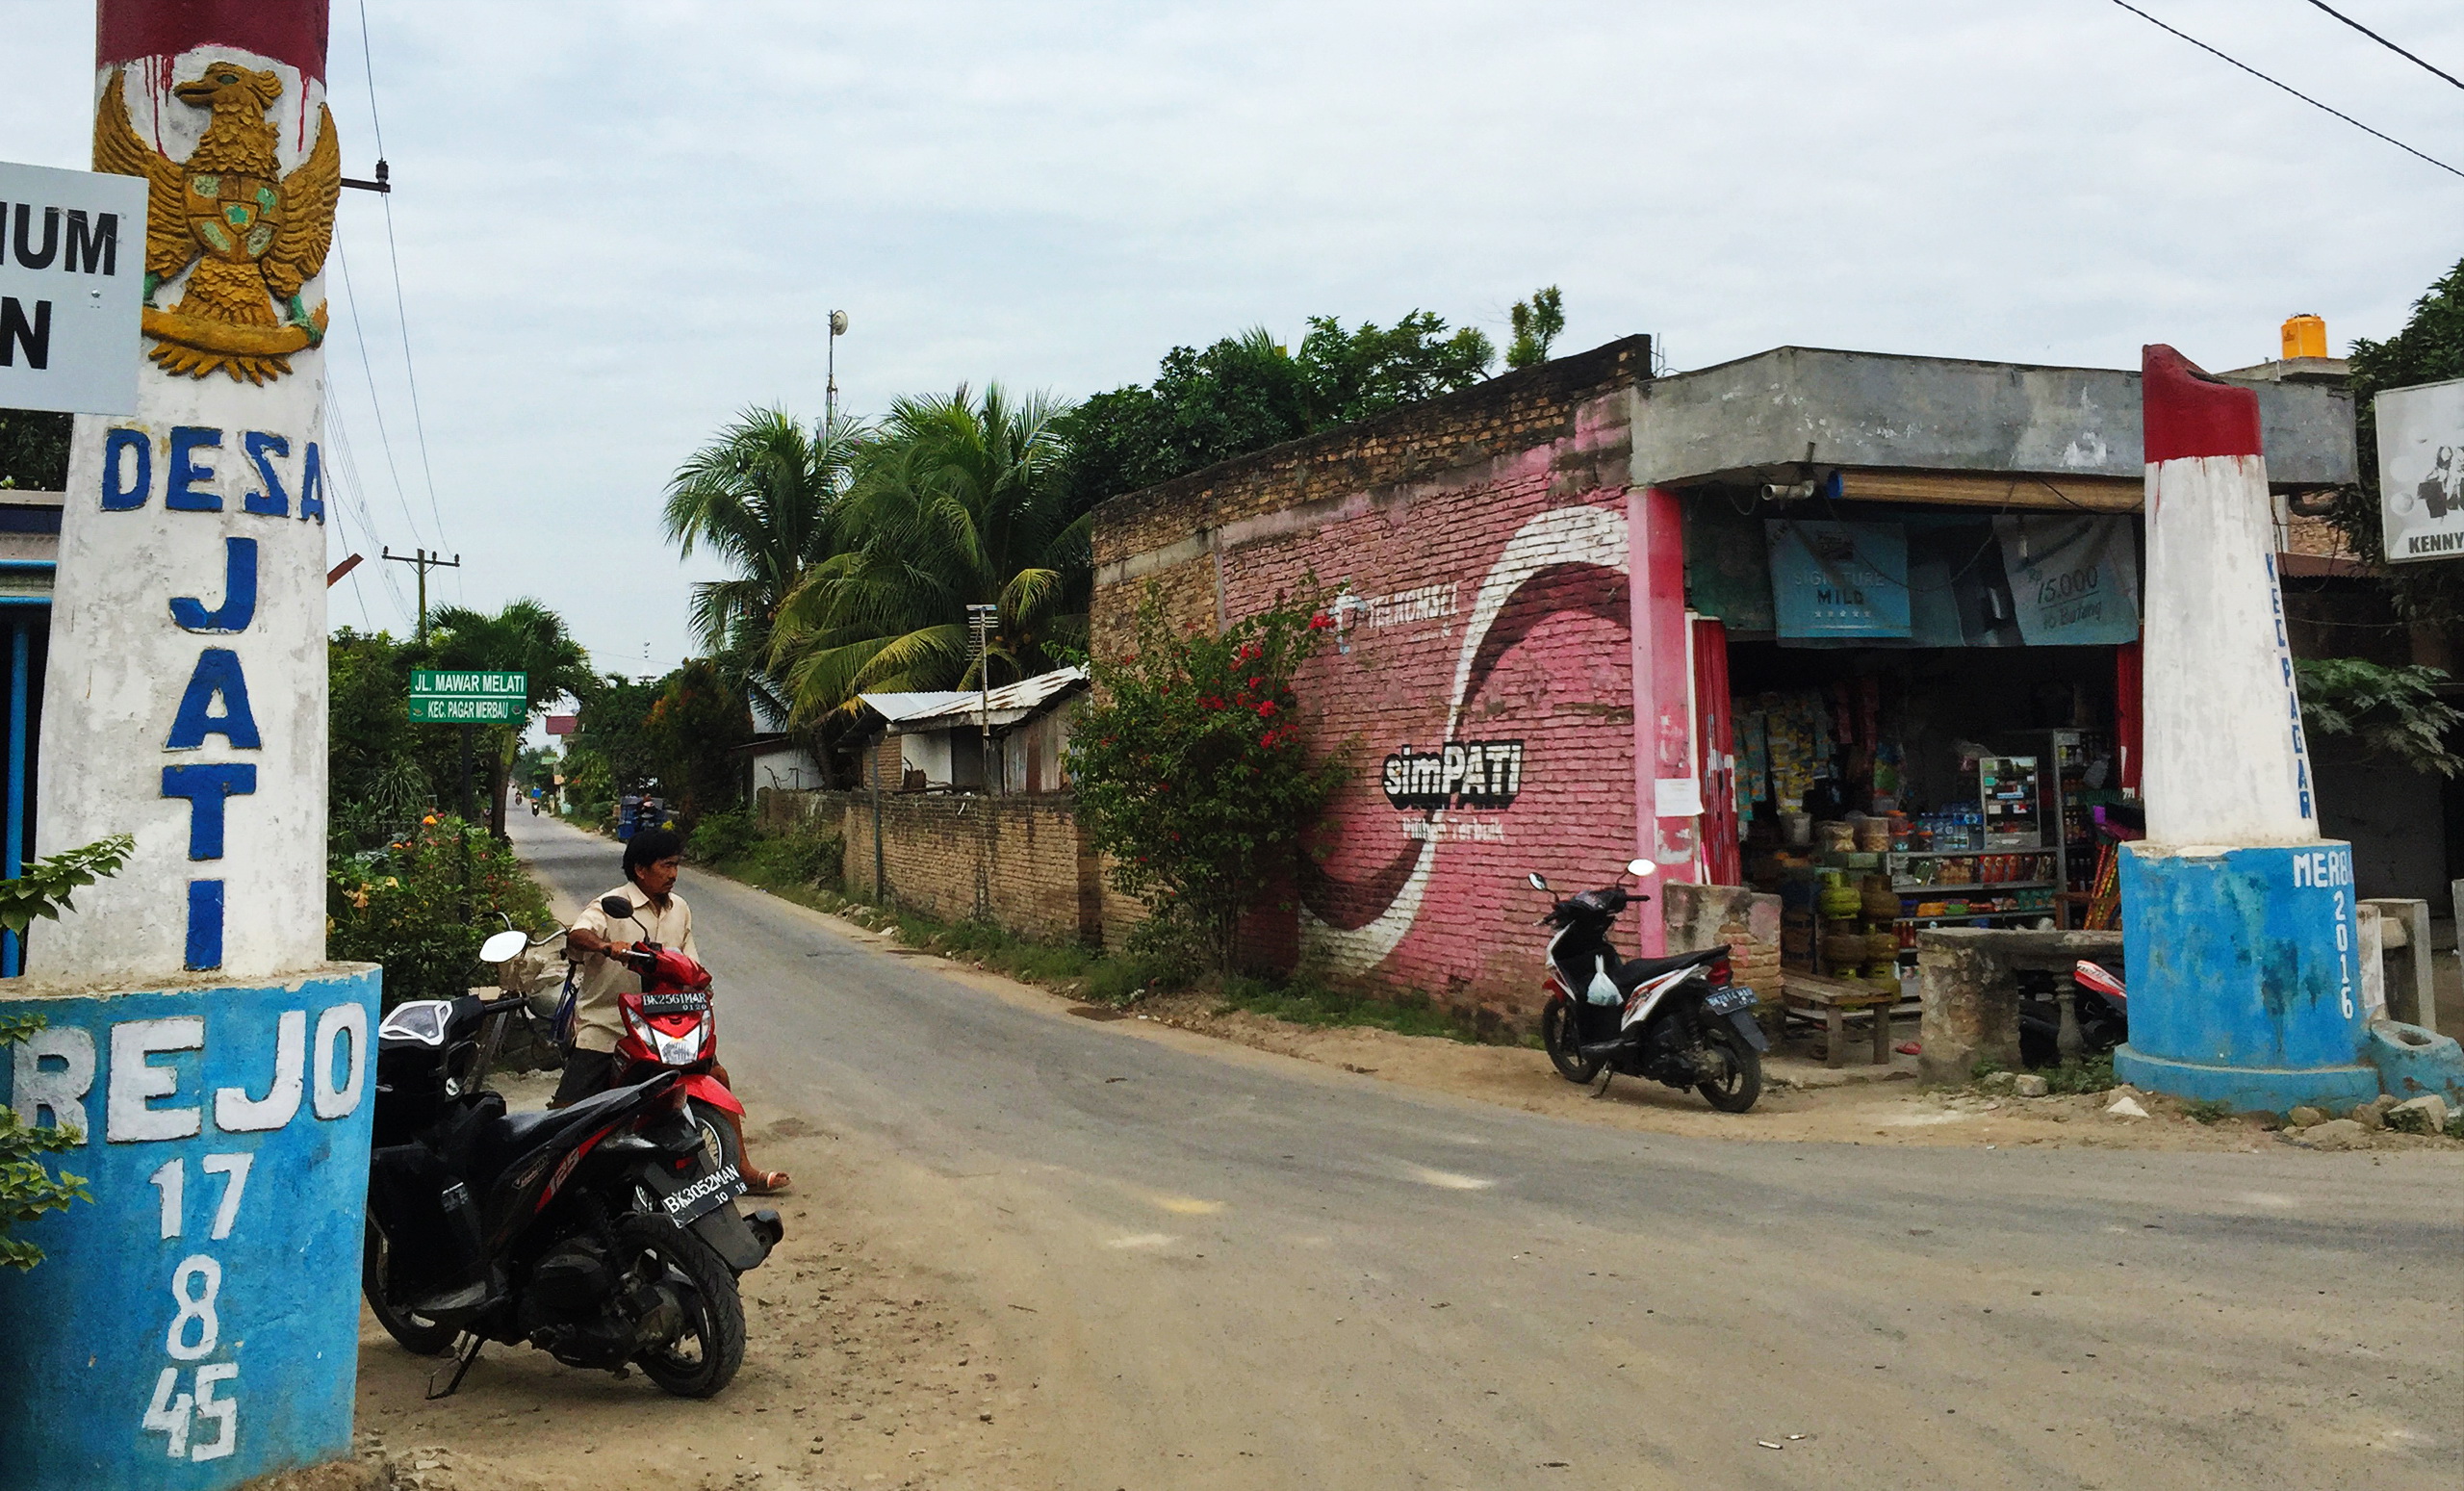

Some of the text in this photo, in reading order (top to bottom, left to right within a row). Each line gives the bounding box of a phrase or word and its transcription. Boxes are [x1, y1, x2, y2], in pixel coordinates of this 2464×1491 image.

[100, 426, 325, 526] DESA
[2408, 532, 2464, 553] KENNY
[1817, 589, 1864, 605] MILD
[415, 675, 525, 692] JL. MAWAR MELATI
[427, 701, 508, 719] KEC. PAGAR MERBAU
[162, 536, 262, 971] JATI
[1383, 744, 1523, 796] simPATI
[2333, 889, 2354, 1020] 2016
[149, 1152, 255, 1240] 17
[549, 1147, 579, 1195] 125
[663, 1164, 740, 1214] BK3052MAN
[167, 1254, 221, 1361] 8
[141, 1363, 240, 1461] 45
